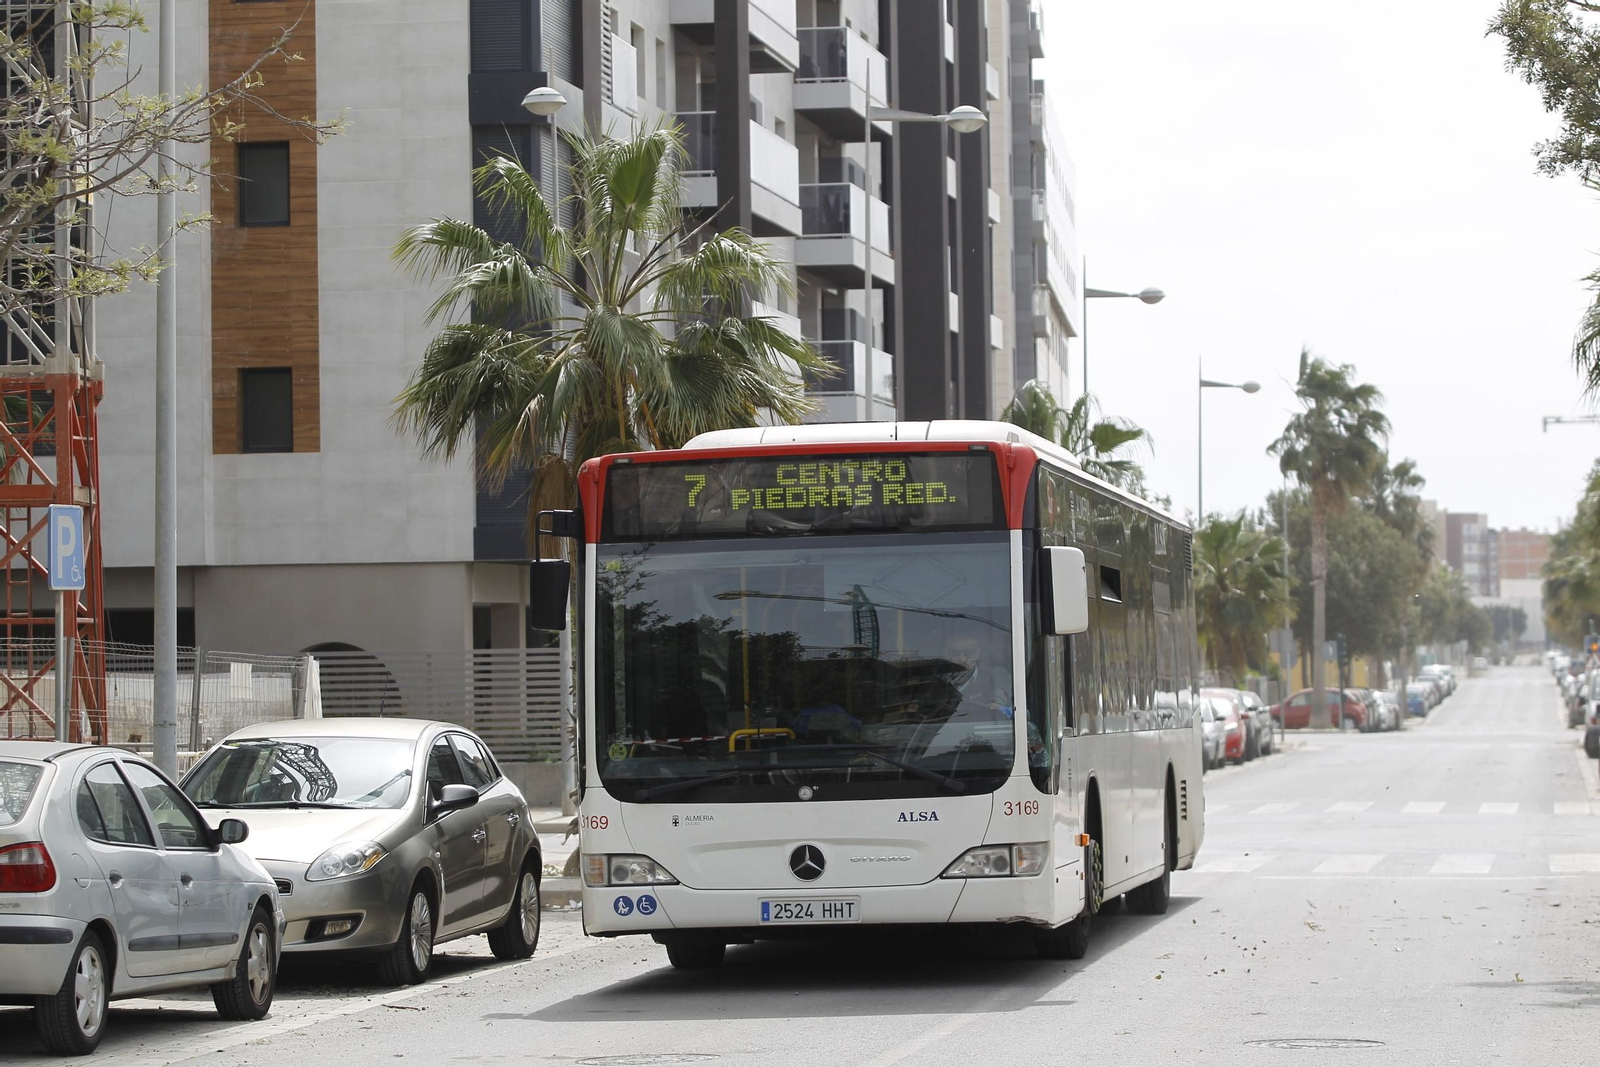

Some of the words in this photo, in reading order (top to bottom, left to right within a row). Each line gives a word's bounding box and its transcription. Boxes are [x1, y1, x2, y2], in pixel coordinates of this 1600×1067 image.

[777, 460, 906, 485] CENTRO
[685, 474, 706, 507] 7
[731, 484, 872, 510] PIEDRAS
[883, 482, 956, 505] RED.
[57, 515, 76, 579] P
[897, 811, 939, 823] ALSA
[1003, 800, 1039, 816] 3169
[773, 902, 814, 919] 2524
[822, 902, 855, 919] HHT
